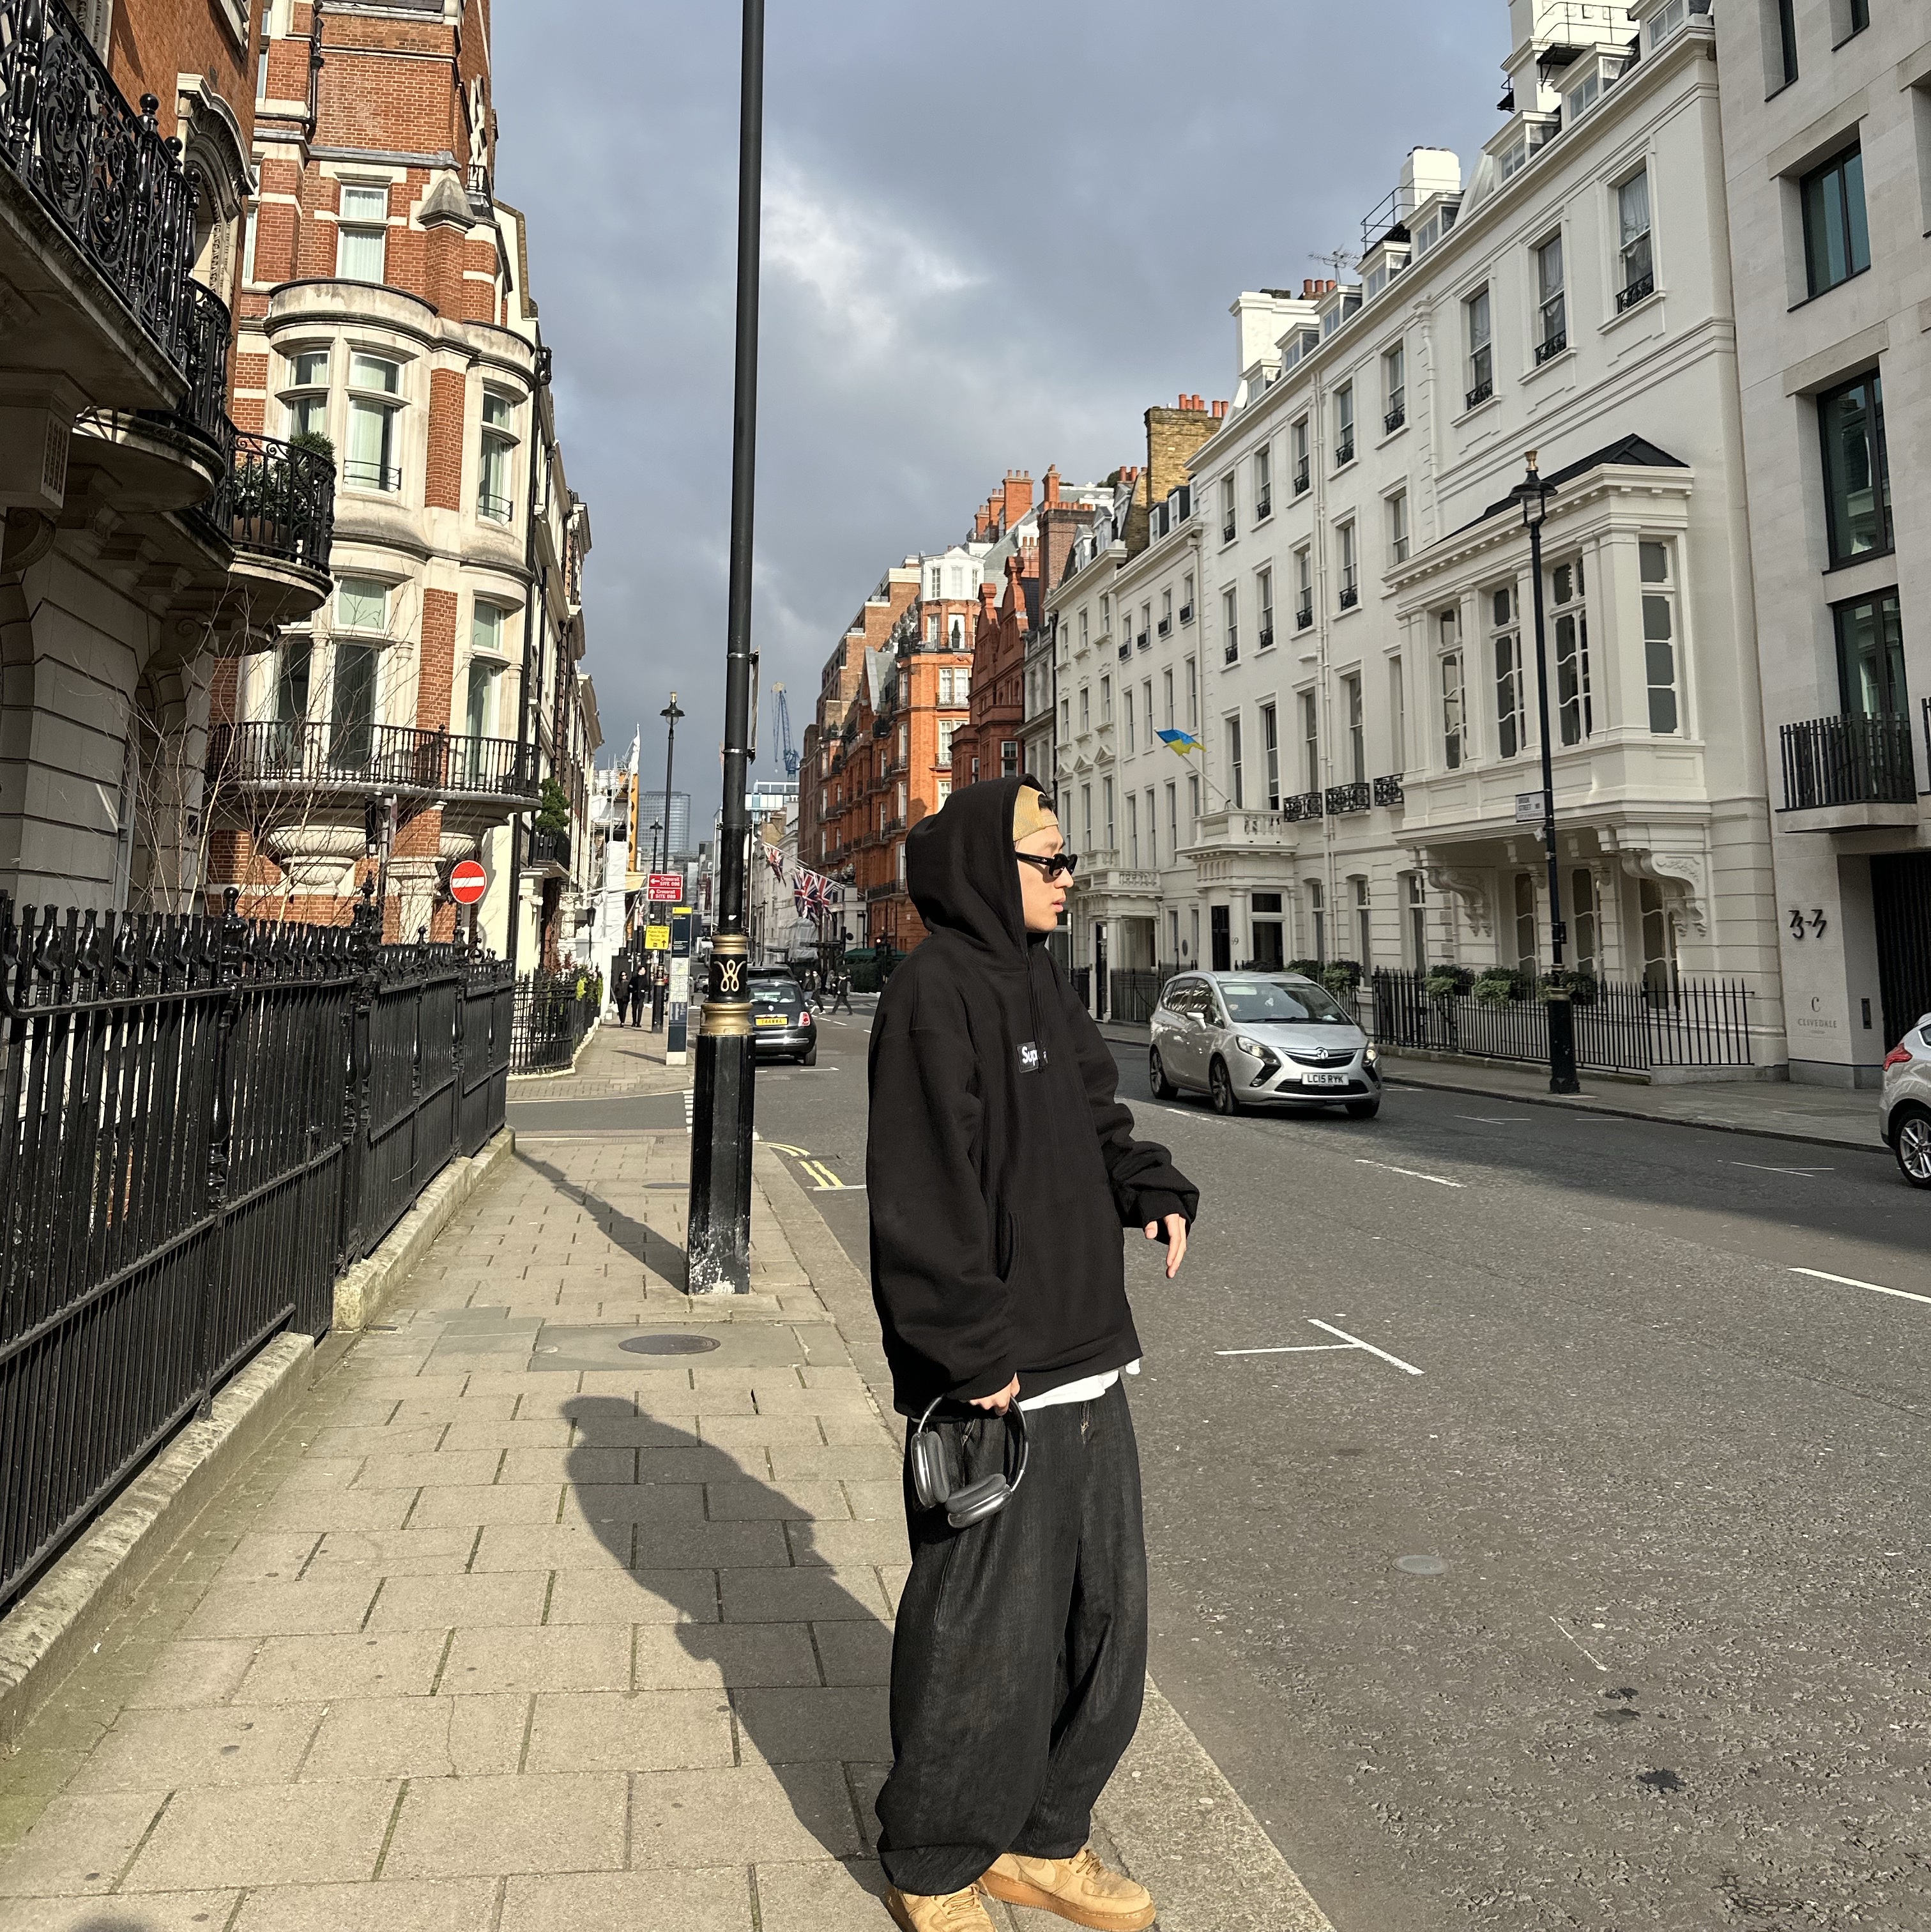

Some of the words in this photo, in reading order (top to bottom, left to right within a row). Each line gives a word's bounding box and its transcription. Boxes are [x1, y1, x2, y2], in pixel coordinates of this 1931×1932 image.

[1797, 1018, 1837, 1029] CLIVEDALE
[1307, 1074, 1327, 1083] LC15
[1327, 1075, 1344, 1084] RYK
